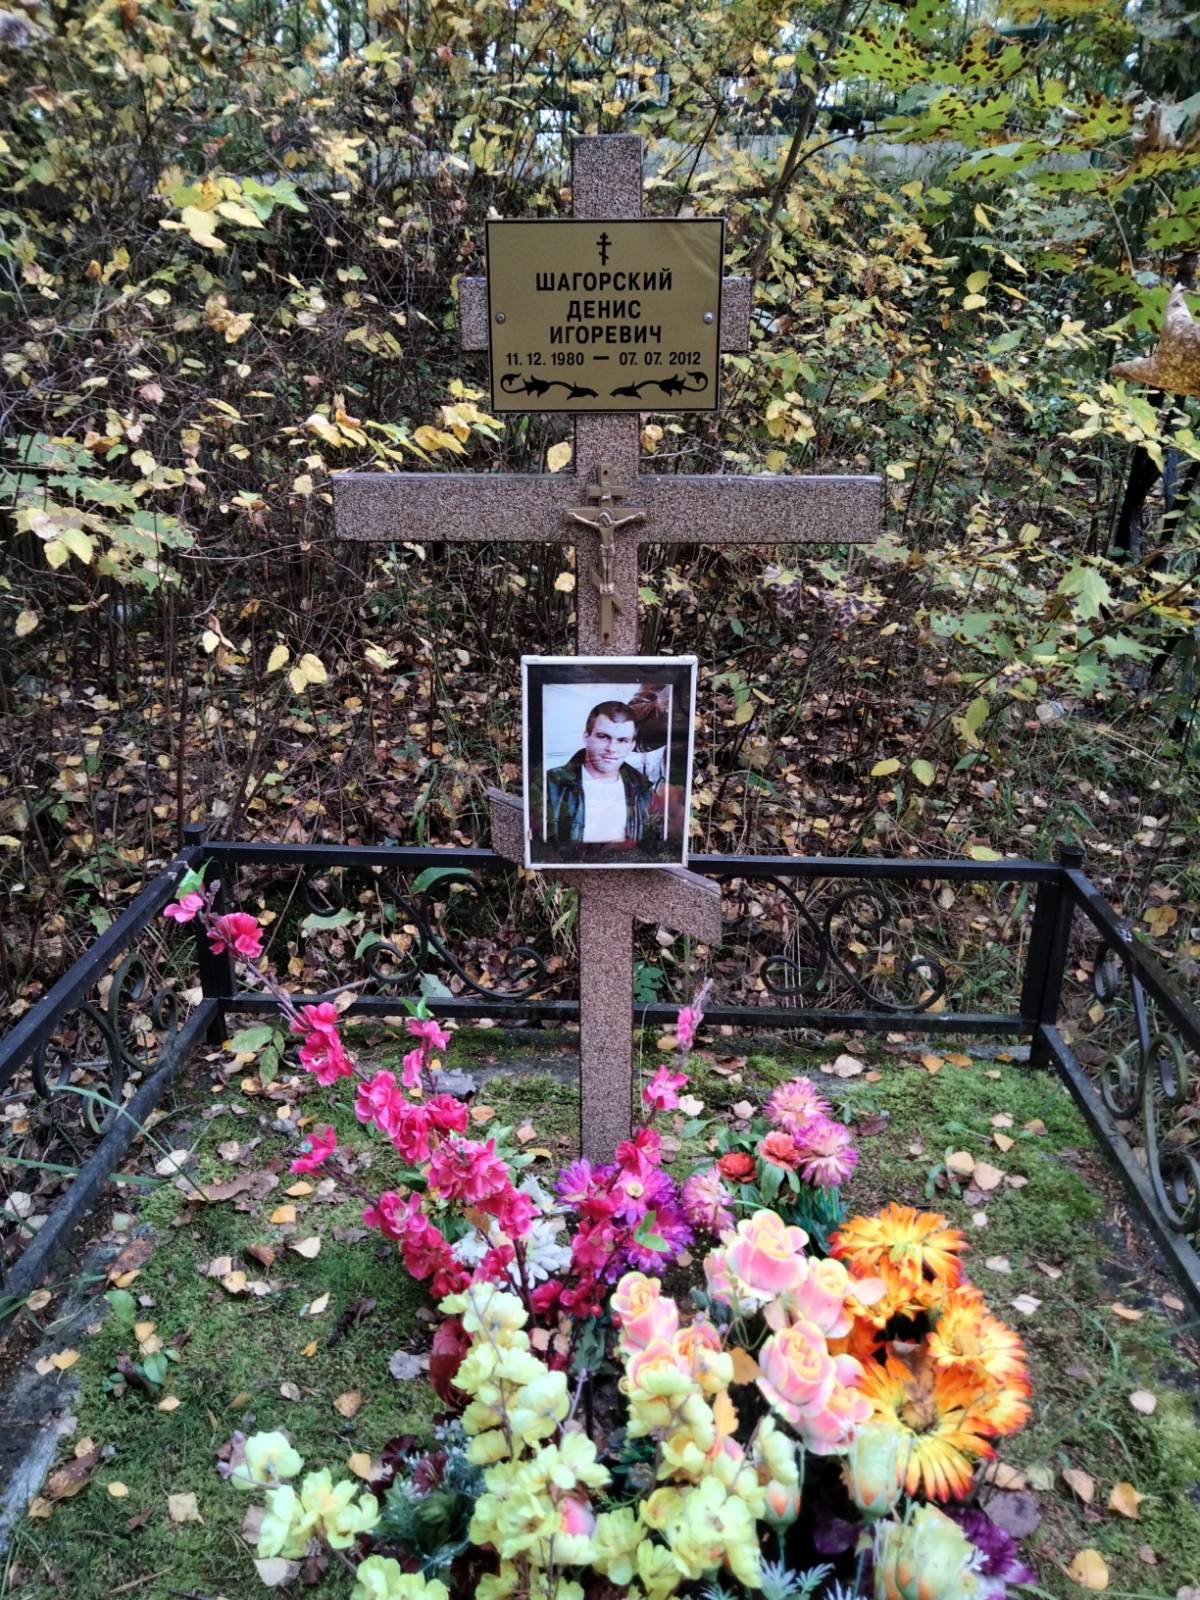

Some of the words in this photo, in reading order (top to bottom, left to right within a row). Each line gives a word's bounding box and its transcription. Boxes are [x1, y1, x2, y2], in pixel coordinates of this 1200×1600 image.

[536, 268, 672, 291] ШАГОРСКИЙ
[567, 300, 641, 322] ДЕНИС
[550, 325, 661, 344] ИГОРЕВИЧ
